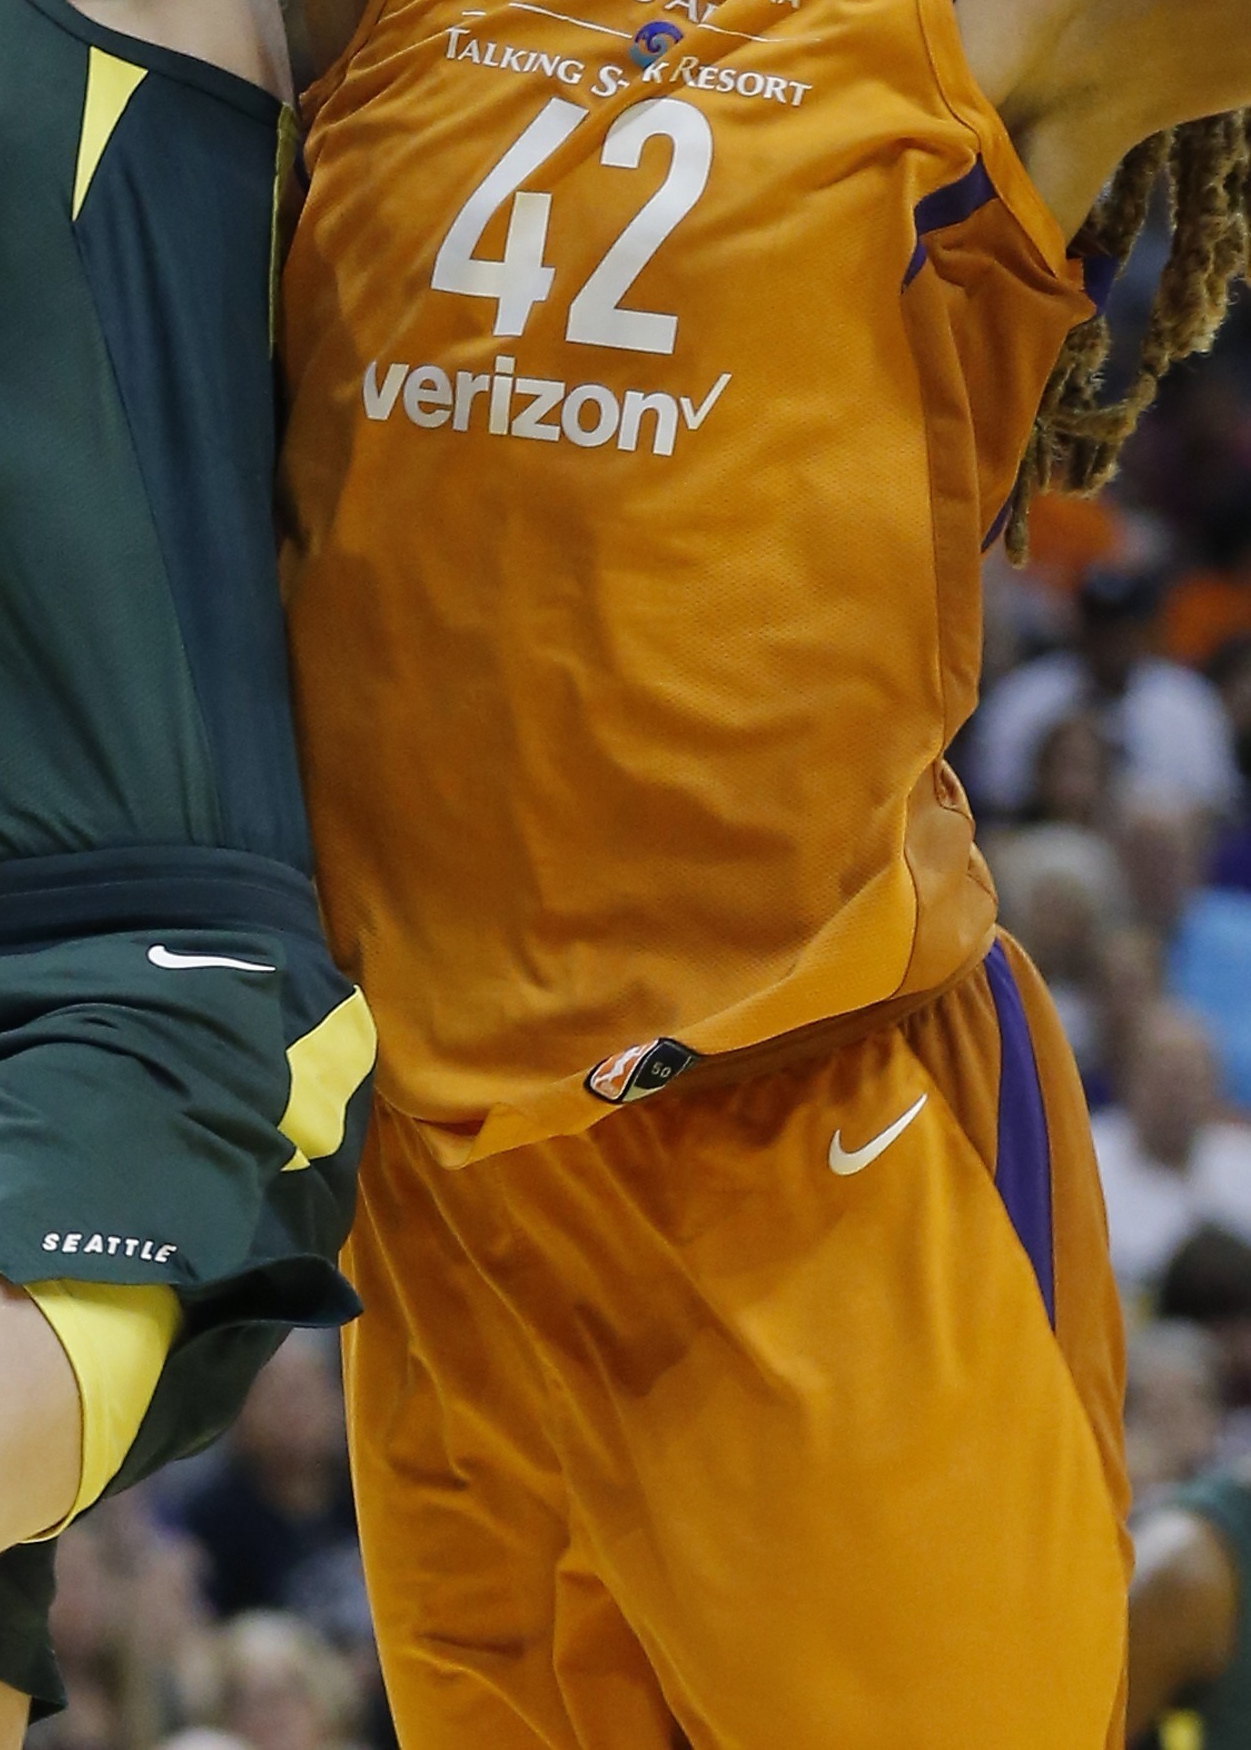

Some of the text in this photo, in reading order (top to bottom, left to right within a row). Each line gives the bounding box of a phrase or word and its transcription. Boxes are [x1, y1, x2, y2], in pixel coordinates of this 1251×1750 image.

[444, 27, 585, 85] TALKING
[669, 55, 812, 107] RESORT
[431, 95, 713, 355] 42
[362, 355, 678, 457] verizon
[41, 1232, 178, 1263] SEATTLE
